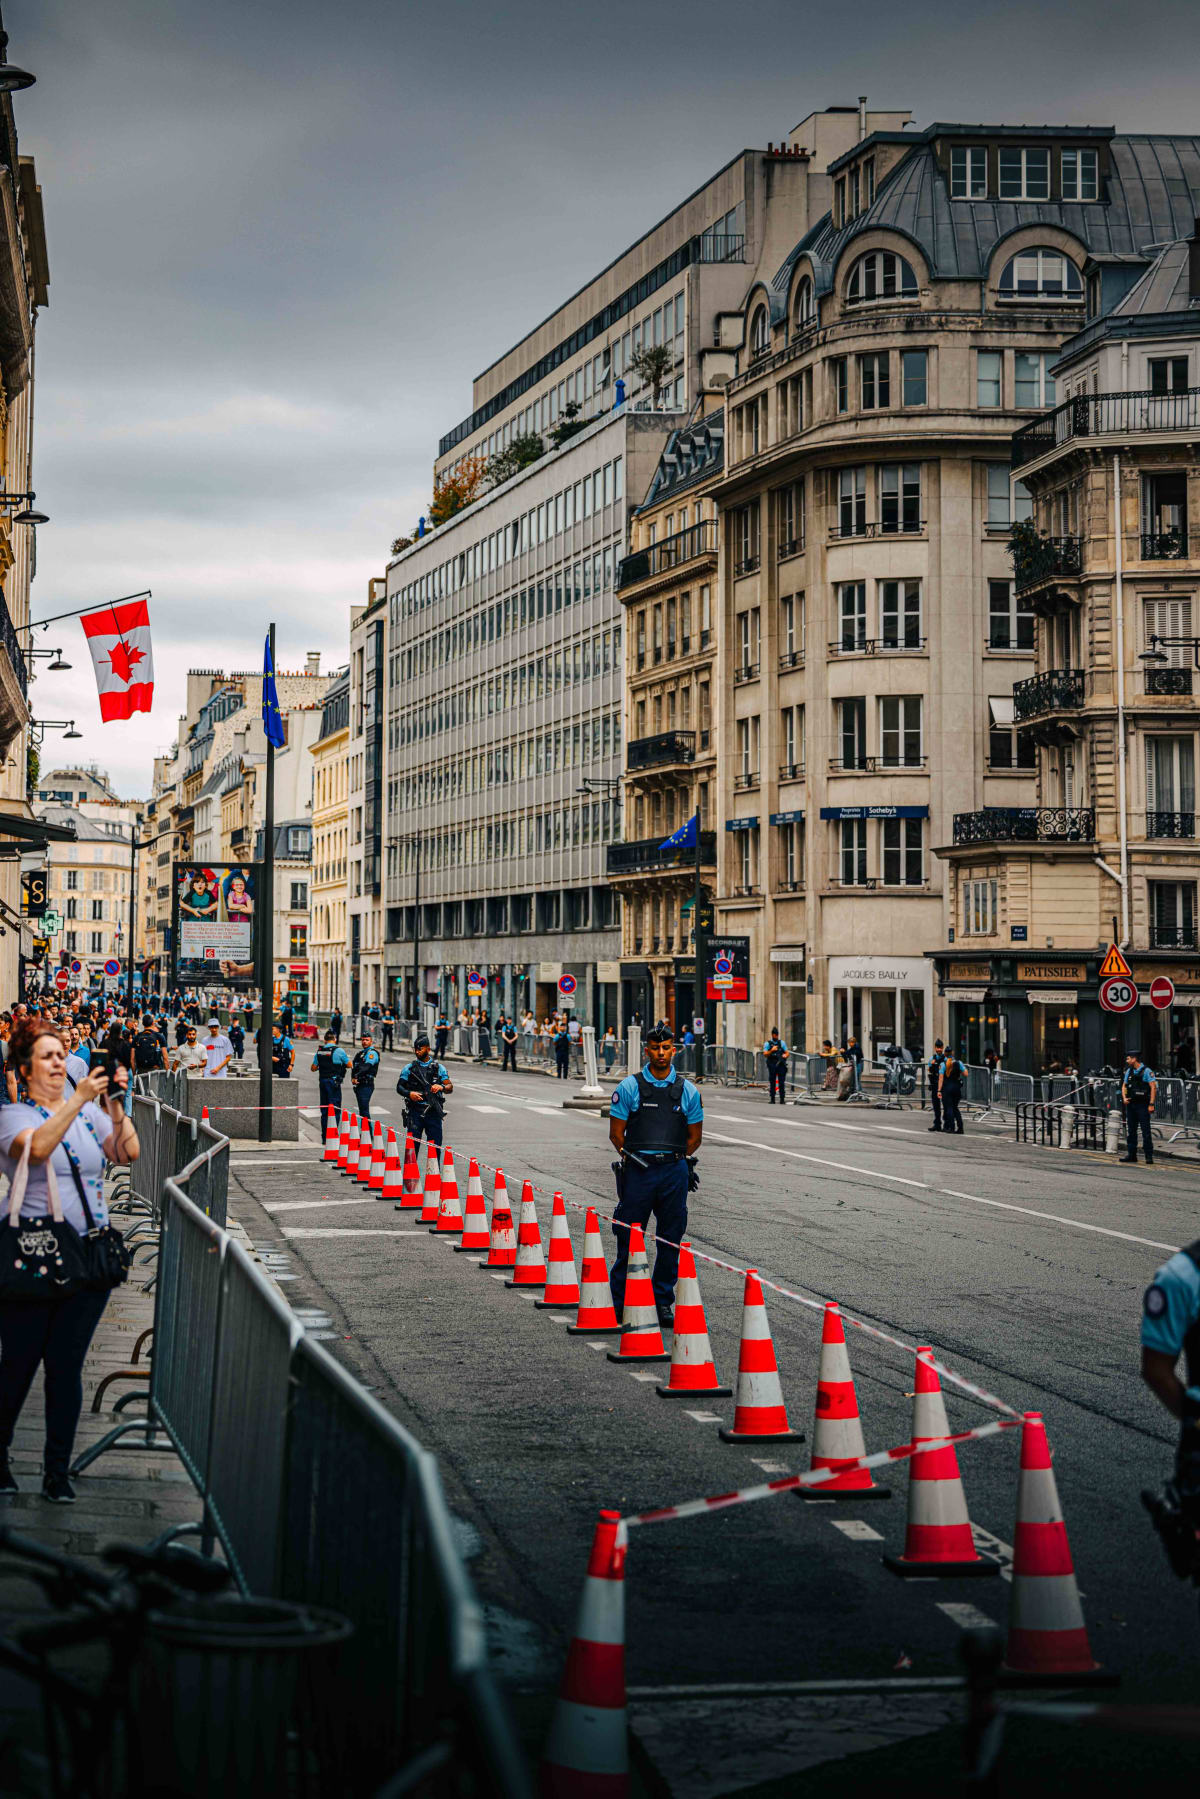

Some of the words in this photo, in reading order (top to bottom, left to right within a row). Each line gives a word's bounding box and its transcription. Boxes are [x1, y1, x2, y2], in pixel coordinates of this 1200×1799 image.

[869, 807, 897, 816] Sotheby's
[842, 970, 875, 979] JACQUES
[878, 970, 908, 980] BAILLY
[1024, 967, 1081, 978] PATISSIER
[1109, 986, 1132, 1003] 30
